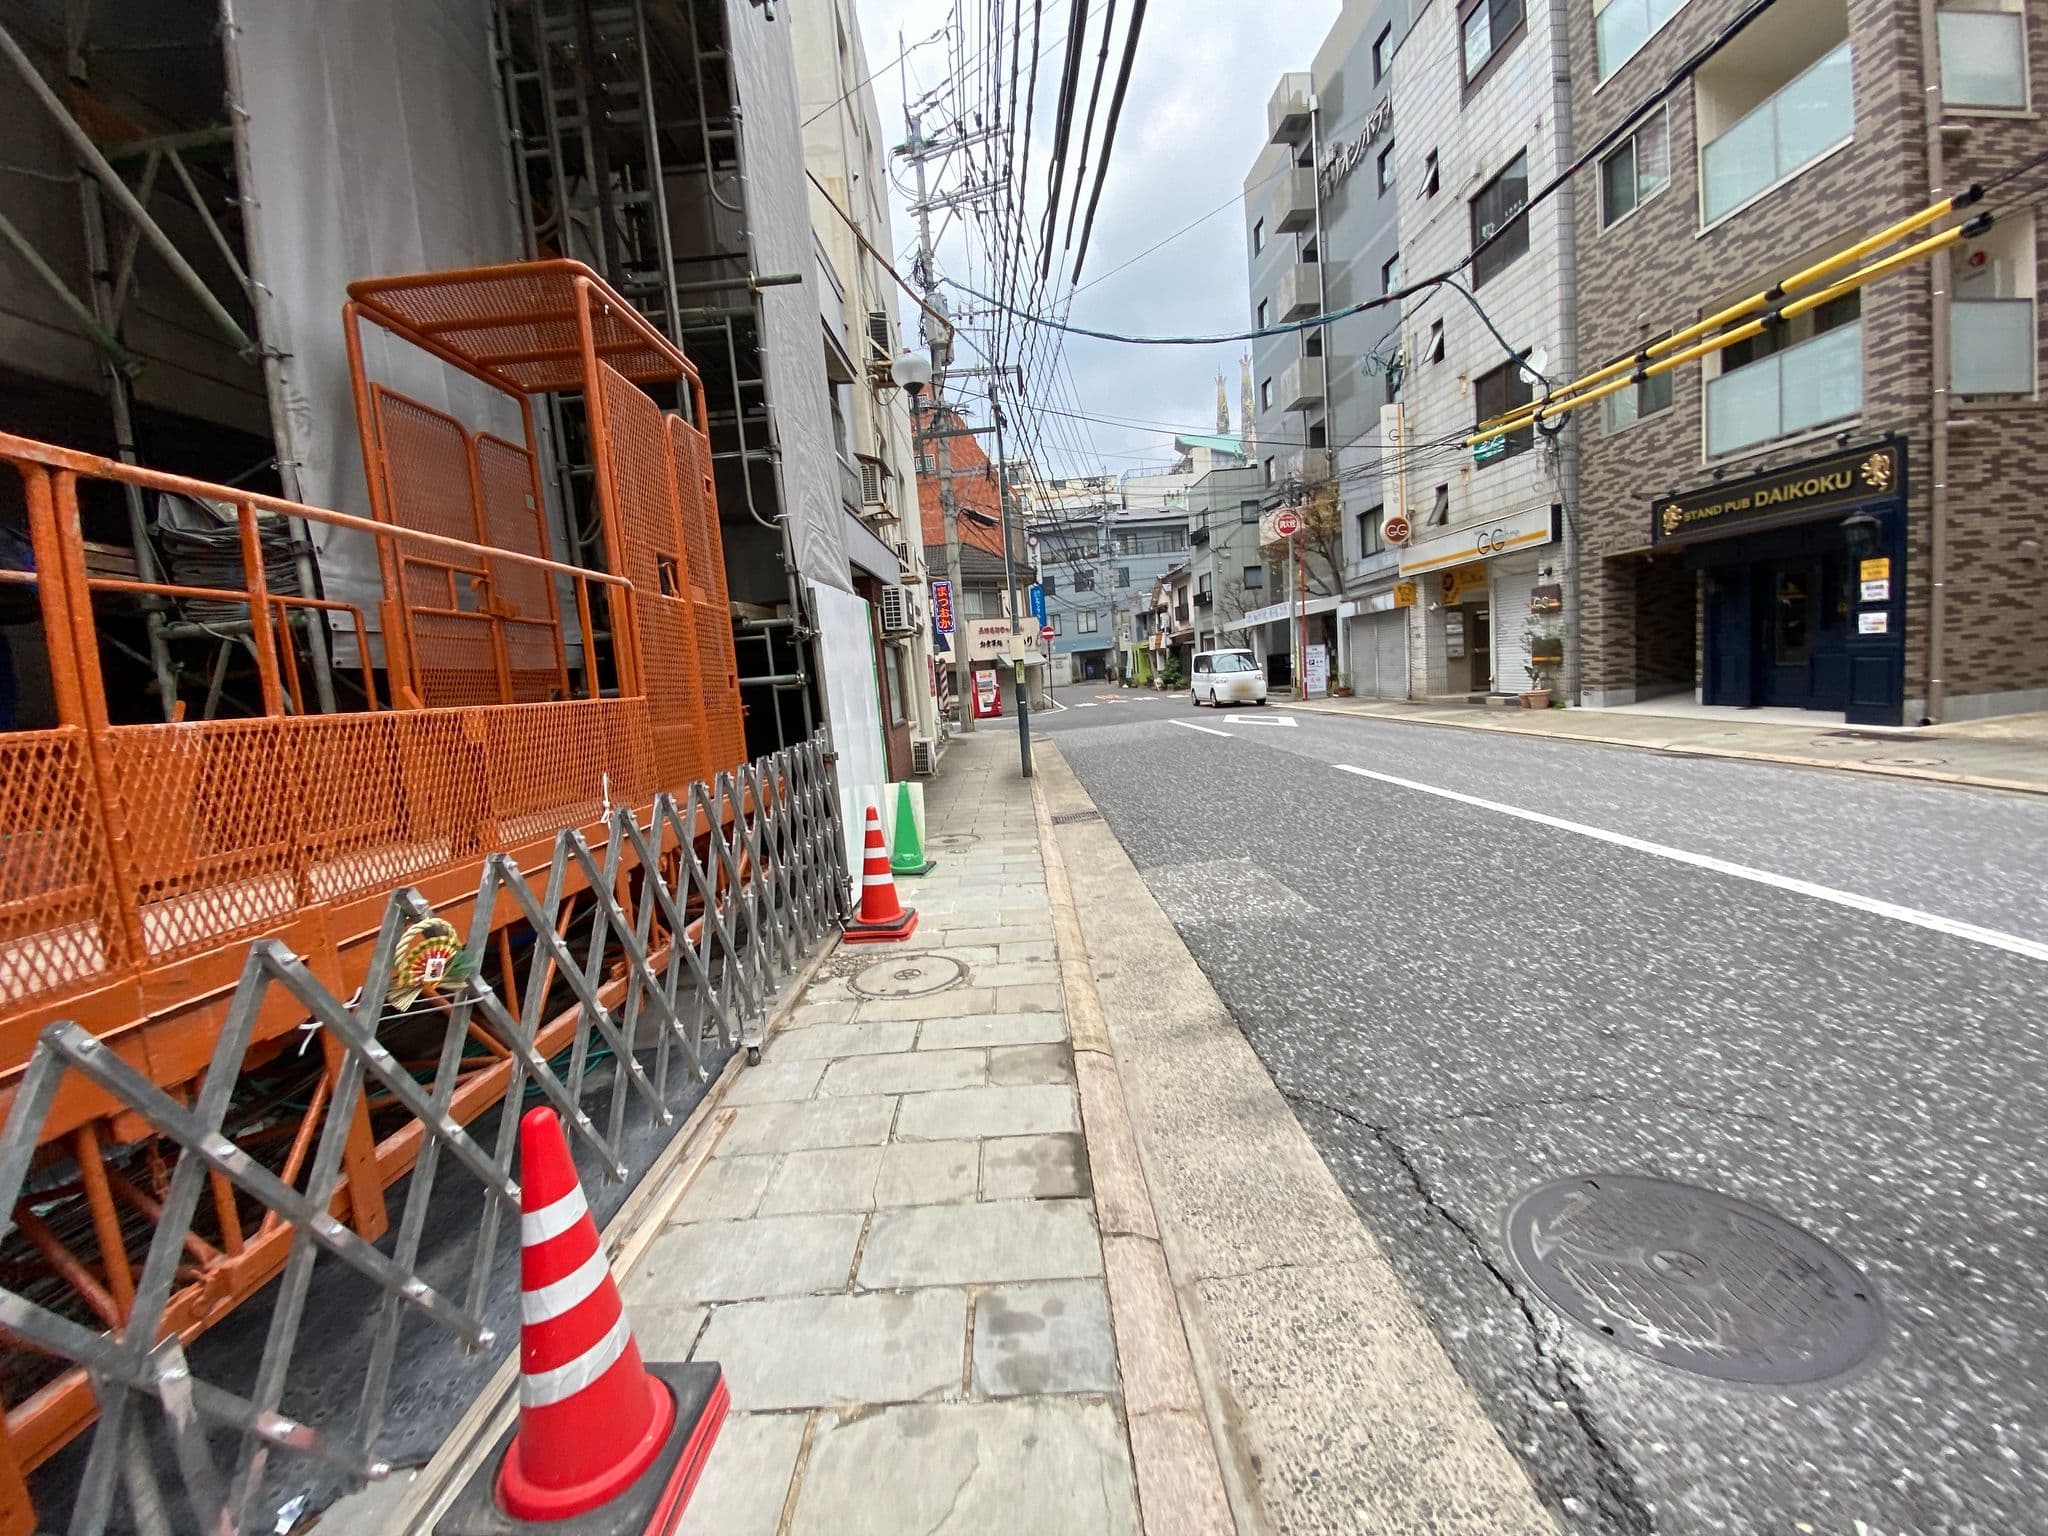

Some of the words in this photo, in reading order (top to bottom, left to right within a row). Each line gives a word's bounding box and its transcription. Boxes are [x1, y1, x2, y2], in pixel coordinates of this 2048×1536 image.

[1683, 504, 1722, 521] STAND
[1724, 497, 1750, 513] PUB
[1754, 470, 1853, 508] DAIKOKU
[1386, 524, 1408, 537] GG
[1477, 528, 1505, 555] GG
[937, 586, 951, 630] まつおか
